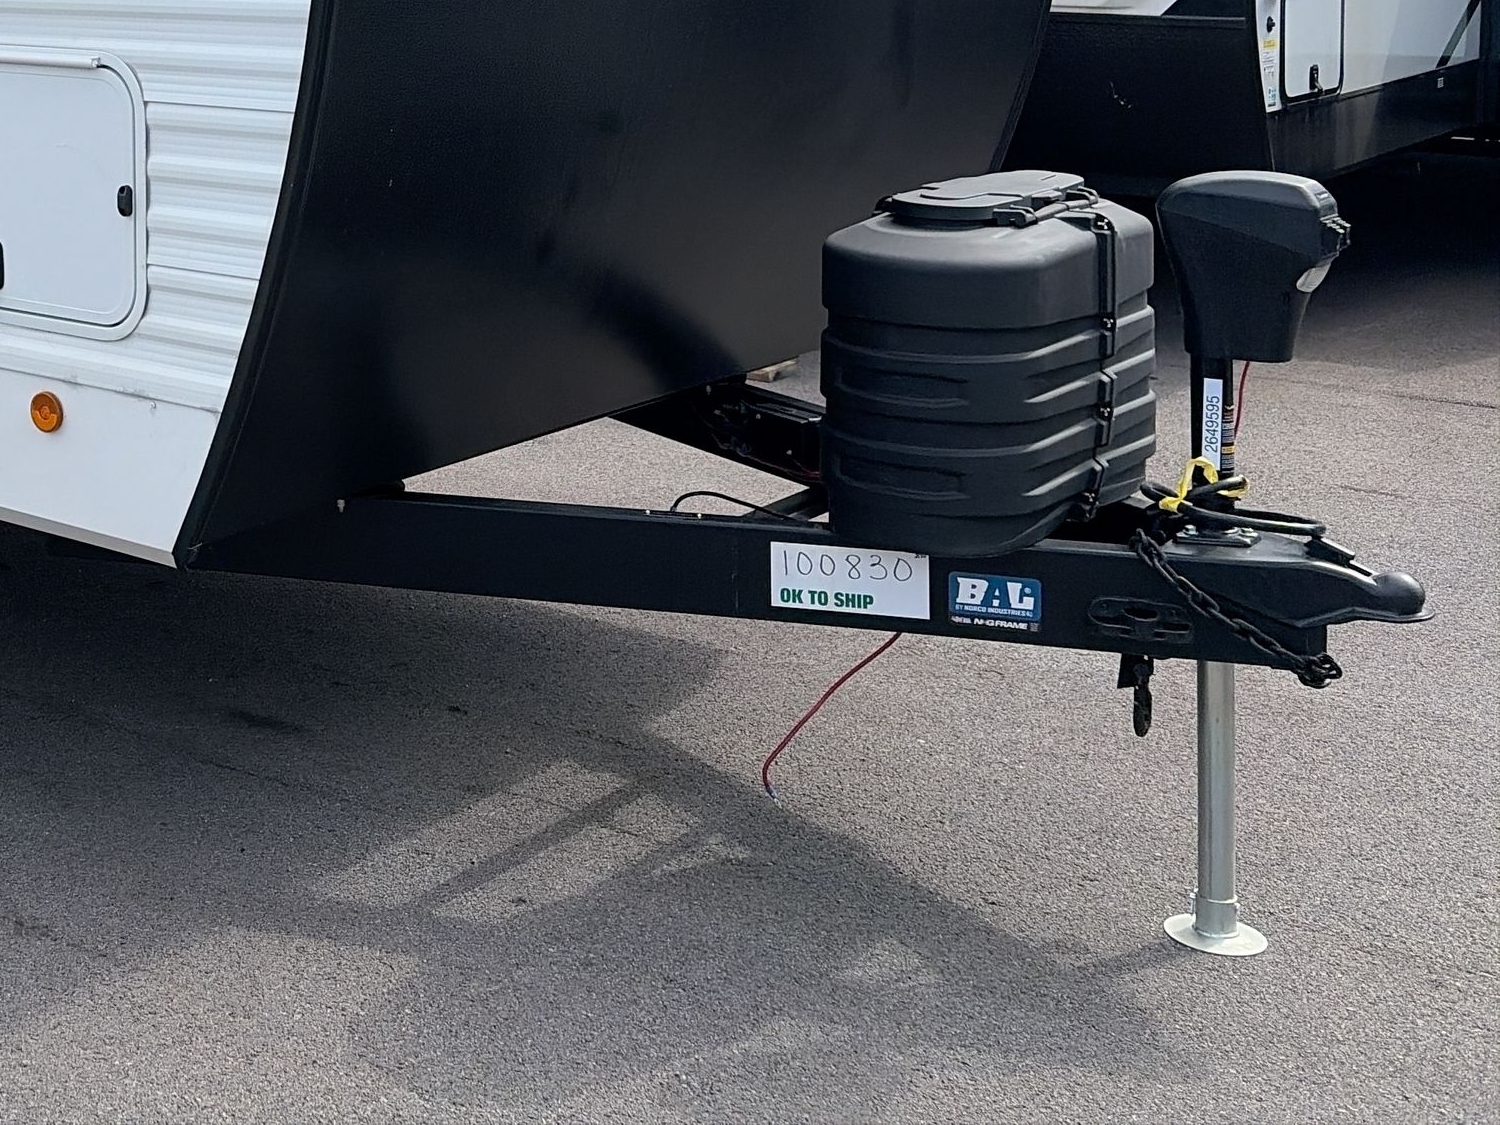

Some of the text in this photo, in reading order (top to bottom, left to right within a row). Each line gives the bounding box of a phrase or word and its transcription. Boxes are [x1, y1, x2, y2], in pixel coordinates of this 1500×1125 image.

[1204, 395, 1220, 453] 2649595
[783, 550, 913, 582] 100830
[780, 587, 874, 609] OK TO SHIP
[956, 576, 1035, 611] BAL
[964, 605, 987, 613] NORCO
[988, 607, 1026, 617] INDUSTRIES
